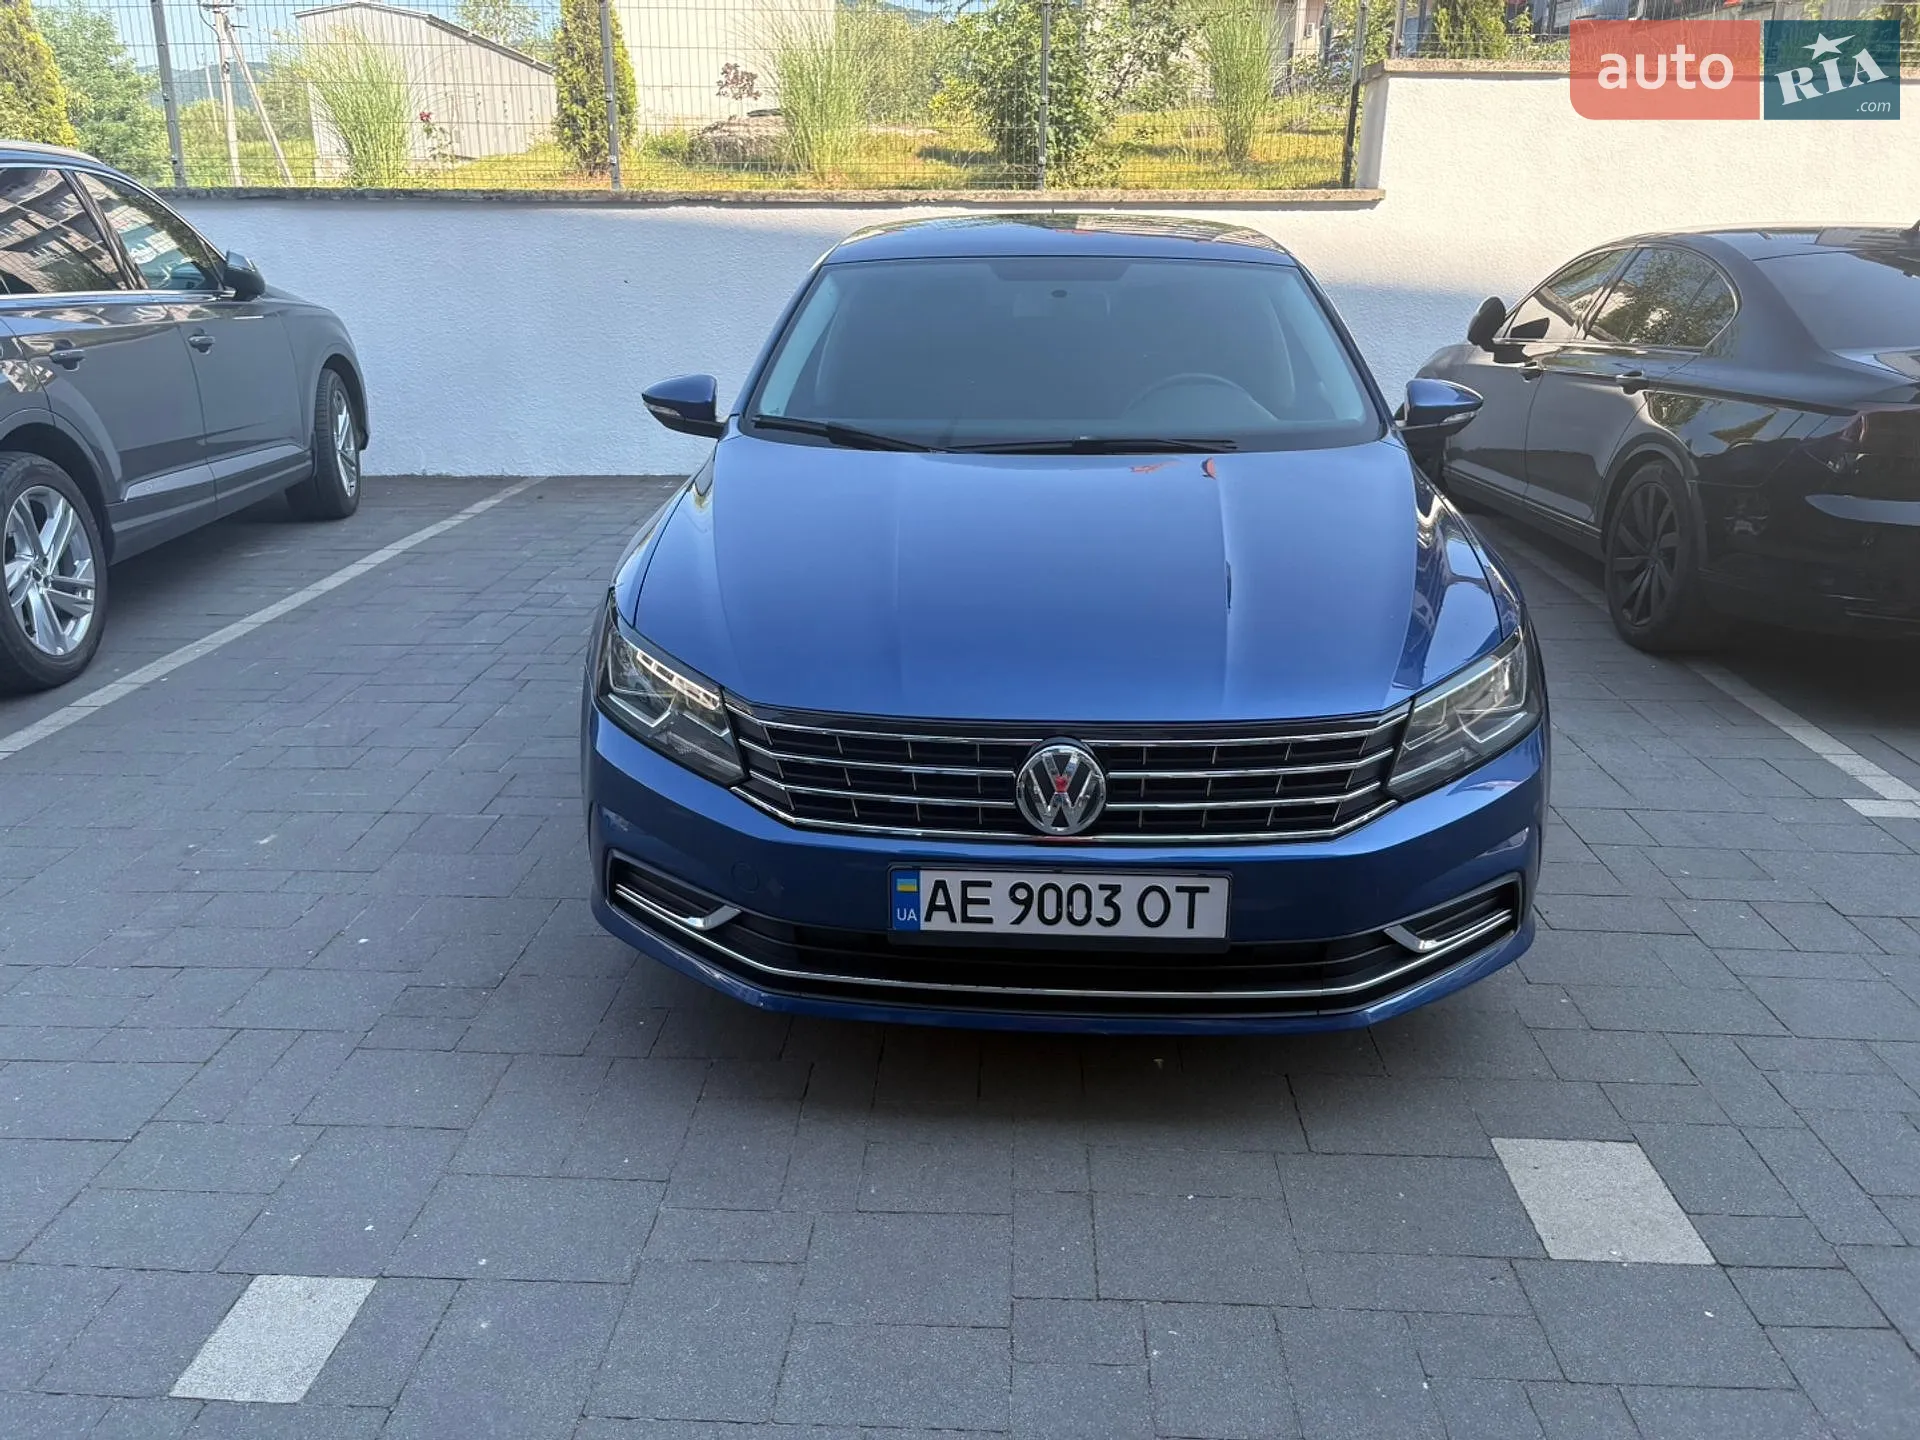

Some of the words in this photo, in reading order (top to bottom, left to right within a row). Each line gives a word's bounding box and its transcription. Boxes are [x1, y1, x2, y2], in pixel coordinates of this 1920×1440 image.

[897, 907, 917, 922] UA
[924, 878, 994, 924] AE
[1009, 881, 1122, 927] 9003
[1137, 884, 1210, 929] OT
